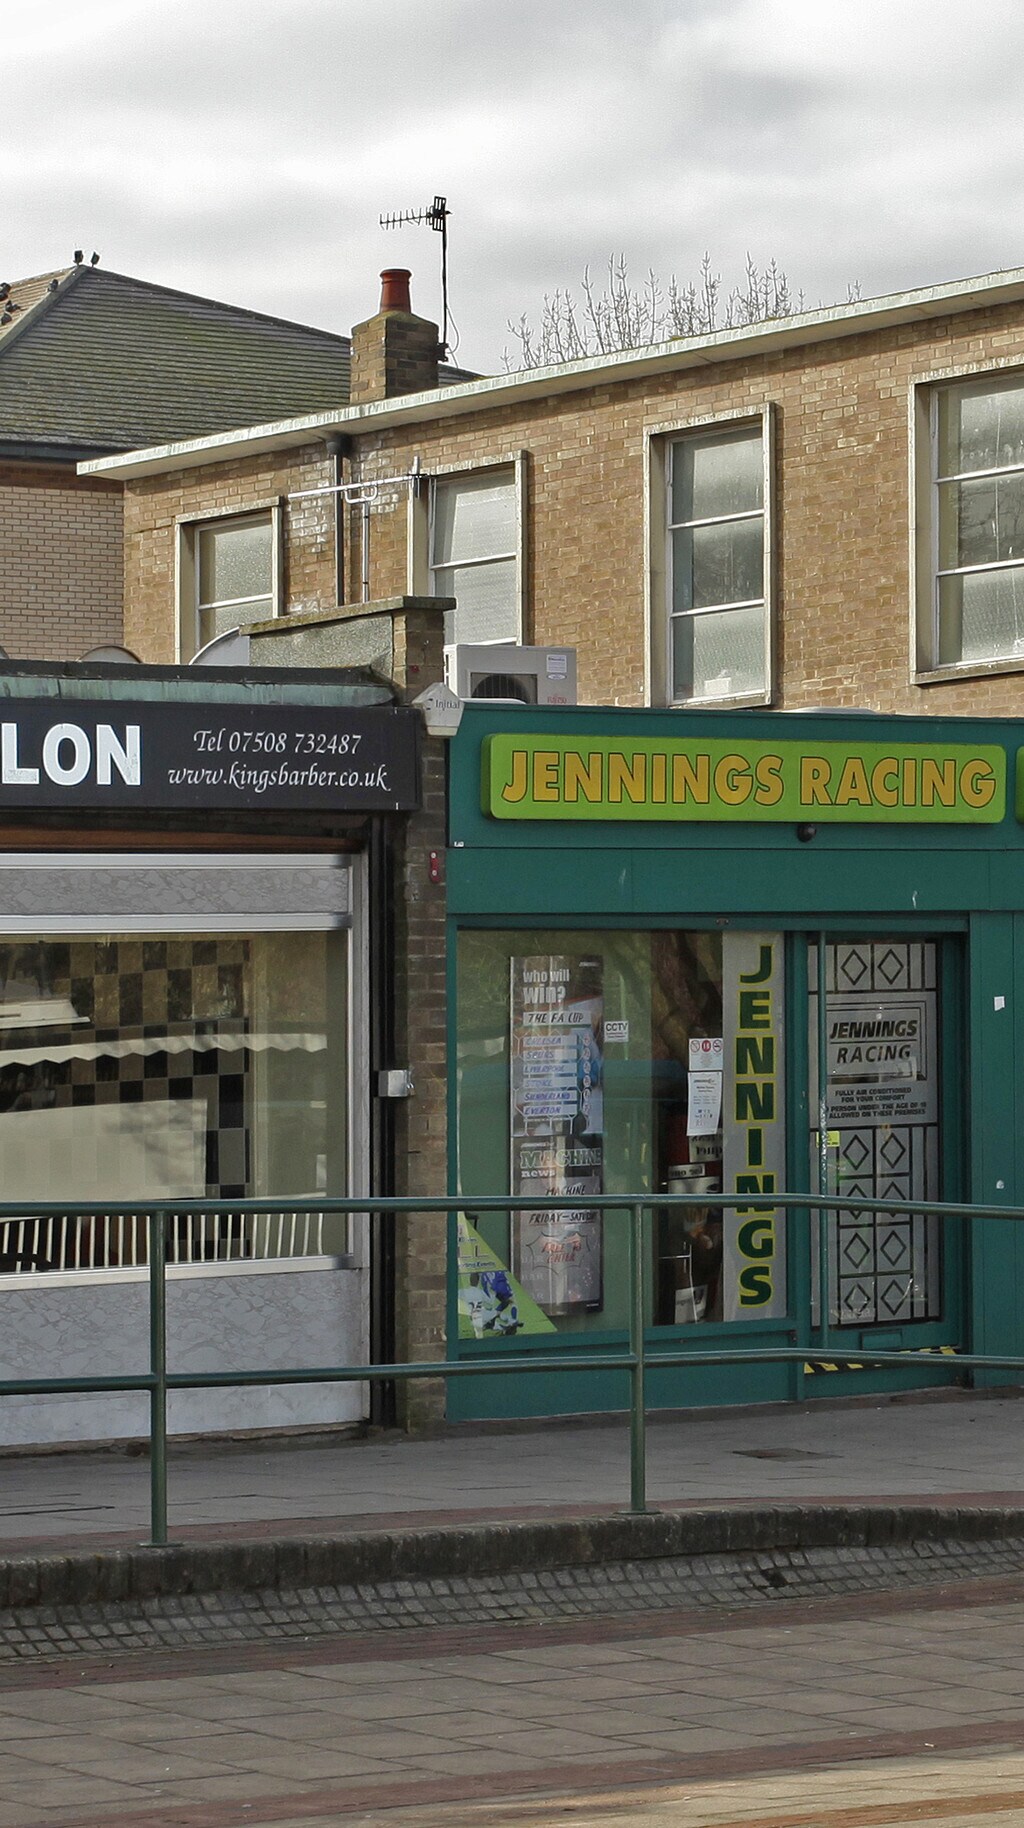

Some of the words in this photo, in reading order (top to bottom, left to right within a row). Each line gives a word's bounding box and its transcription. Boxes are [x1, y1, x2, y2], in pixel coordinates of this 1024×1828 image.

[193, 728, 226, 752] Tel
[229, 731, 288, 753] 07508
[294, 733, 362, 755] 732487
[1, 722, 141, 786] LON
[168, 761, 391, 793] www.kingsbarber.co.uk
[501, 750, 785, 805] JENNINGS
[800, 756, 996, 809] RACING
[523, 969, 547, 983] who
[550, 968, 570, 983] will
[523, 984, 566, 1004] win?
[529, 1013, 547, 1023] THE
[551, 1012, 564, 1023] FA
[605, 1023, 627, 1032] CCTV
[830, 1020, 918, 1039] JENNINGS
[837, 1044, 911, 1064] RACING
[525, 1104, 562, 1114] EVERTON
[735, 944, 775, 1307] JENNINGS
[520, 1147, 602, 1169] MACHINE
[521, 1169, 556, 1178] news
